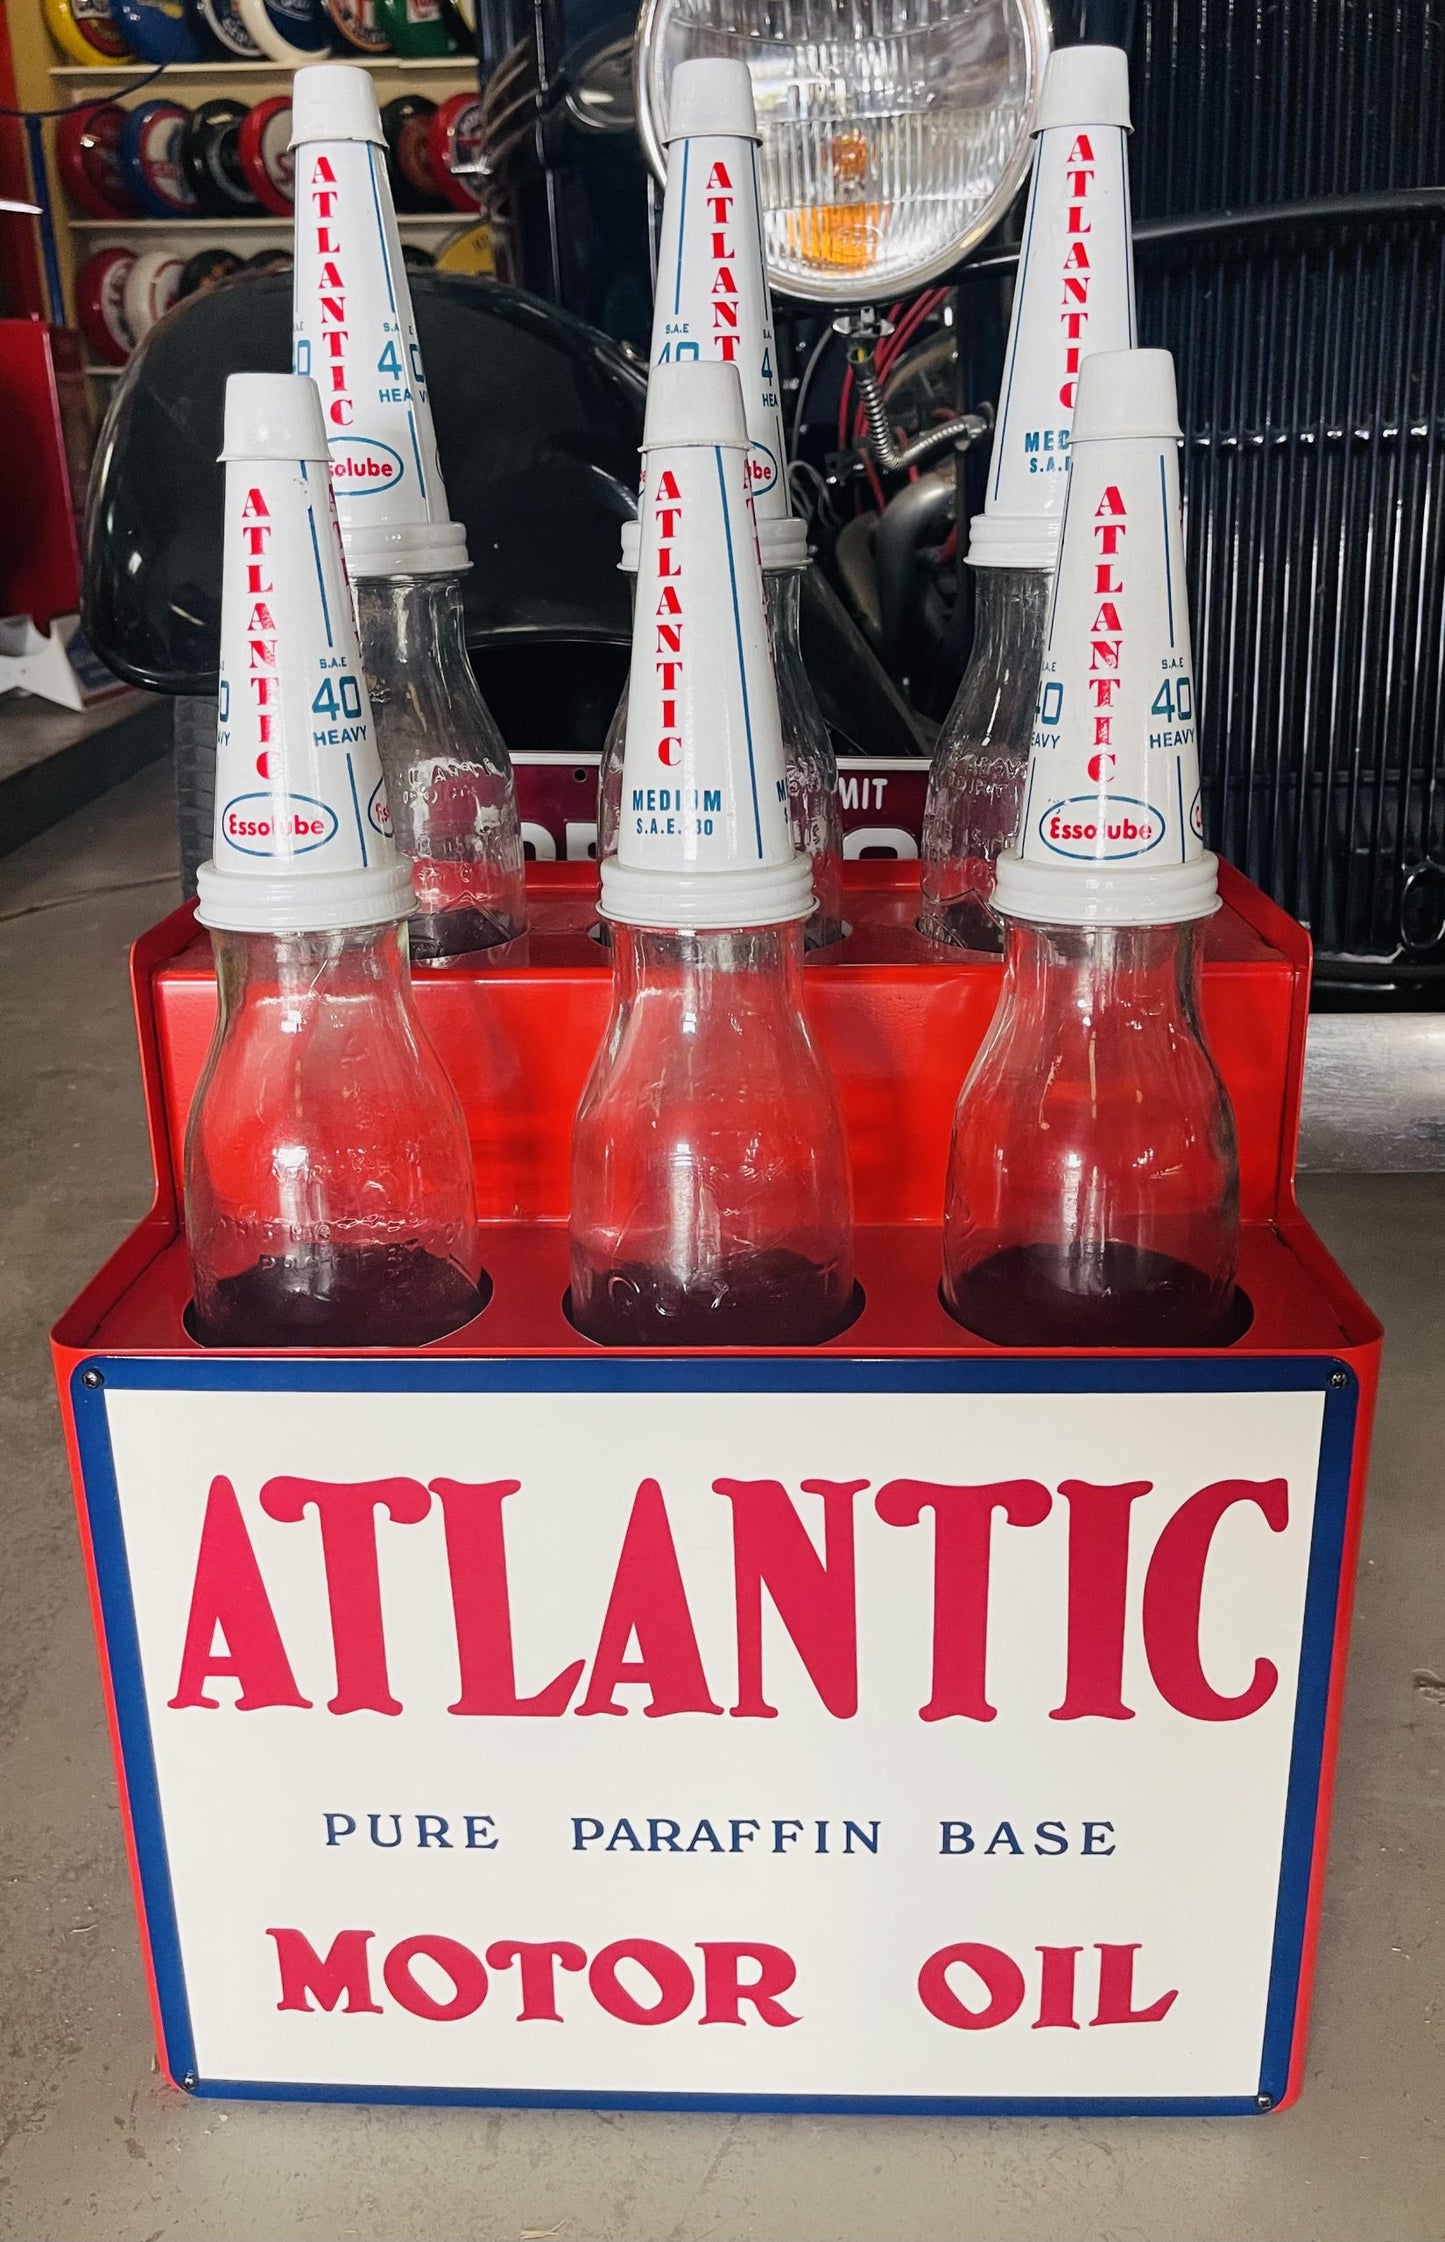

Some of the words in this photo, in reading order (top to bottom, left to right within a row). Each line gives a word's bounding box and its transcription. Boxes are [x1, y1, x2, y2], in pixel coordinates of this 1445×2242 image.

[706, 161, 740, 362] ATLANT
[1059, 134, 1095, 409] ATLANTIC
[312, 156, 354, 426] ATLANTIC
[665, 324, 690, 334] S.A.E
[293, 339, 311, 377] 0
[761, 347, 773, 387] 4
[762, 393, 778, 407] HEA
[1025, 429, 1070, 453] MED
[329, 457, 393, 478] solube
[242, 488, 280, 781] ATLANTIC
[655, 470, 683, 767] ATLANTIC
[1087, 485, 1127, 783] ATLANTIC
[319, 656, 347, 669] S.A.E
[1161, 657, 1184, 669] S.A.E
[219, 679, 230, 723] 0
[311, 675, 362, 722] 40
[1151, 676, 1192, 724] 40
[313, 725, 368, 748] HEAVY
[1031, 734, 1061, 750] EAVY
[1150, 727, 1195, 749] HEAVY
[632, 789, 722, 812] MEDIM
[229, 812, 325, 837] Essolbe
[1049, 816, 1153, 841] Essoube
[168, 1475, 1288, 1722] ATLANTIC
[324, 1814, 499, 1849] PURE
[571, 1818, 881, 1854] PARAFFIN
[940, 1822, 1116, 1855] BASE
[267, 1928, 802, 2027] MOTOR
[918, 1943, 1178, 2030] OIL
